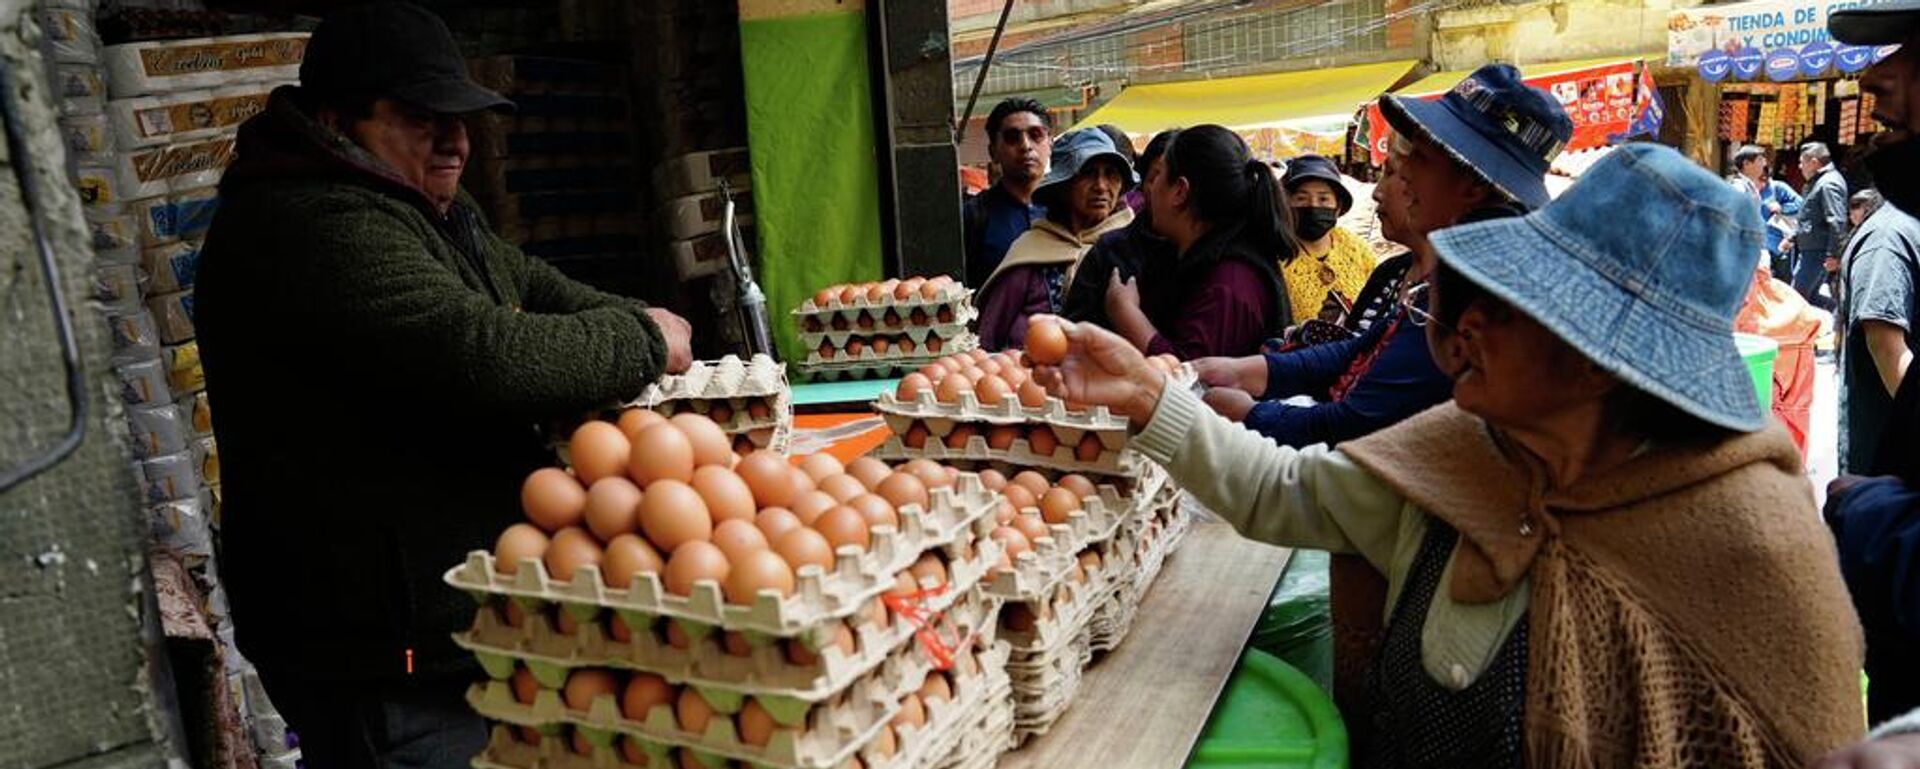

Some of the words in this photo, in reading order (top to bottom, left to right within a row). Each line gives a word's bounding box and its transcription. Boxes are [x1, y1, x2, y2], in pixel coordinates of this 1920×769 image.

[1728, 11, 1784, 31] TIENDA
[1794, 7, 1816, 24] DE
[1743, 35, 1753, 47] Y
